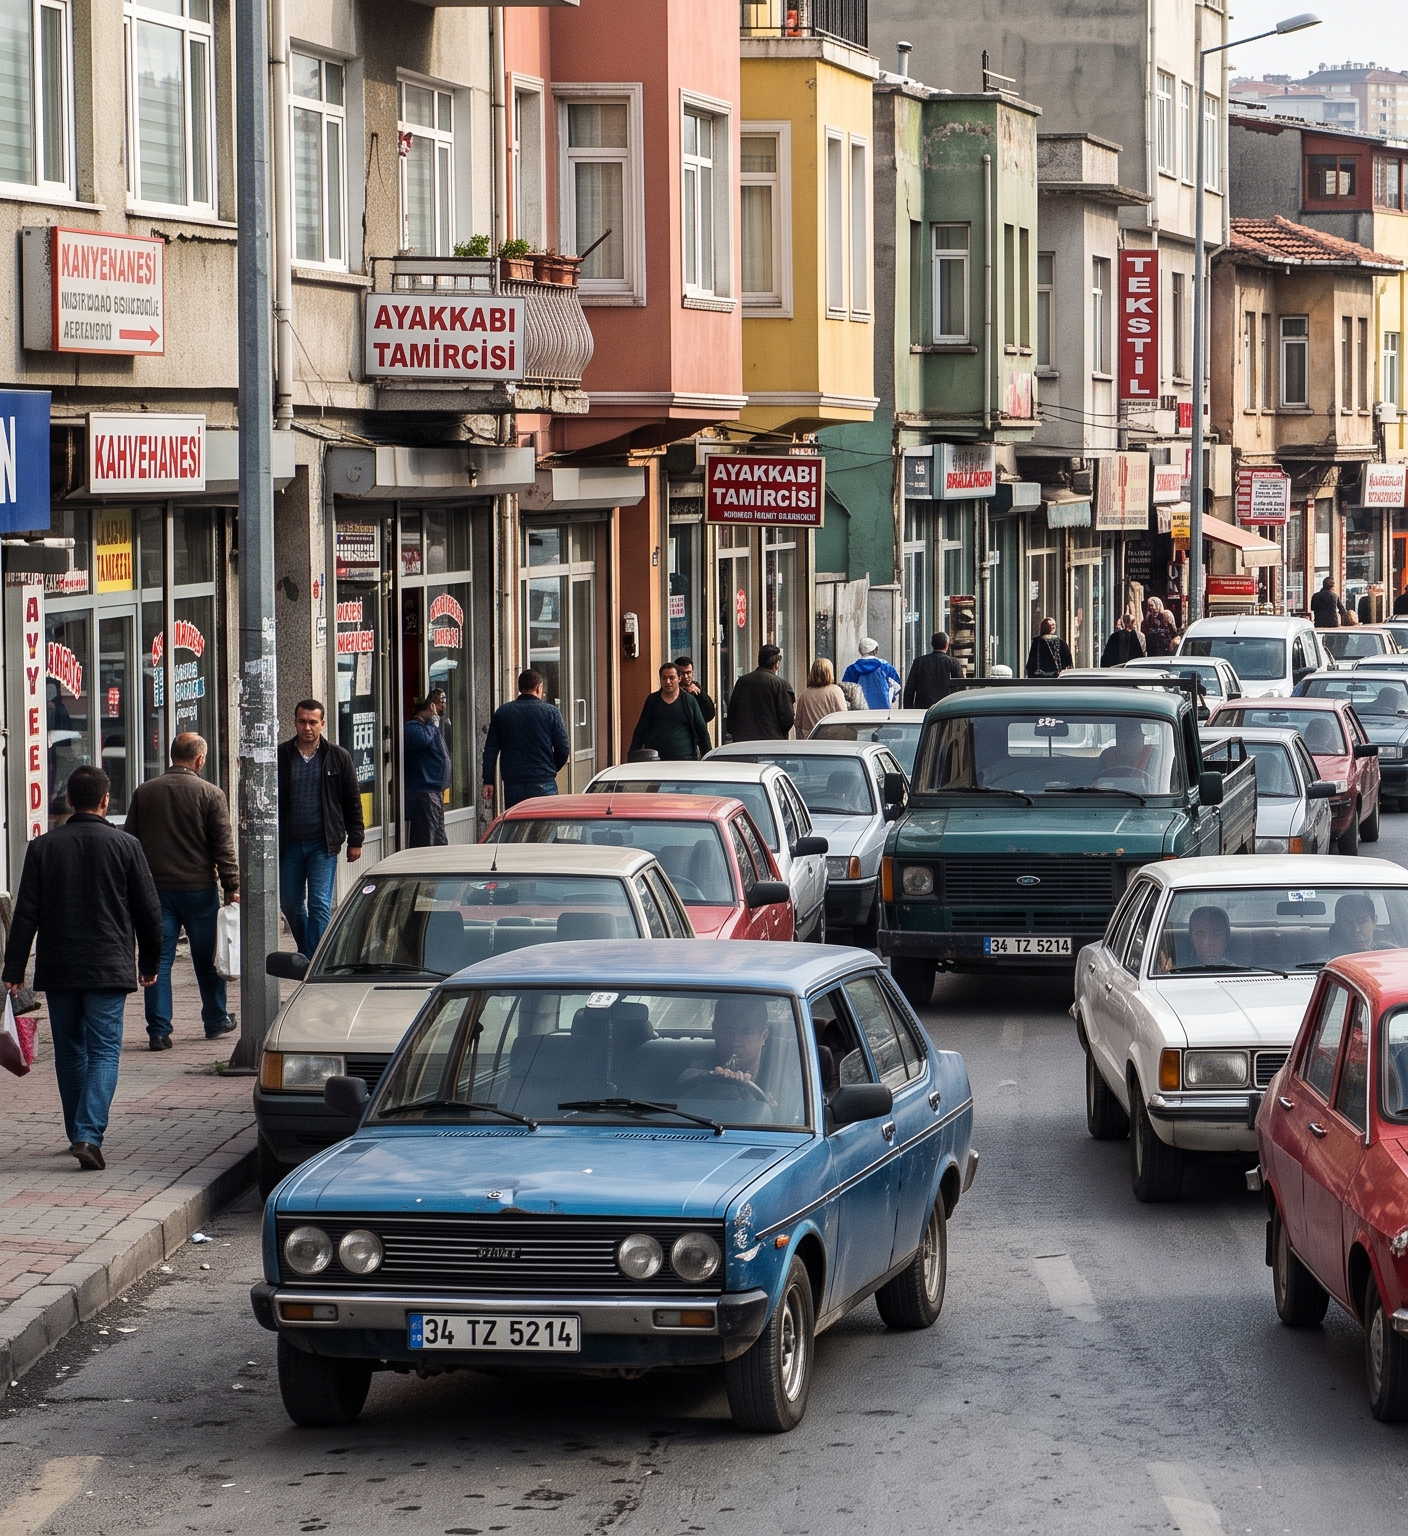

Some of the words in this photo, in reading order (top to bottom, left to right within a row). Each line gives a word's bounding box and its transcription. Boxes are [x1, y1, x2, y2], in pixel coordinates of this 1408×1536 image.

[374, 305, 515, 332] AYAKKABI
[1126, 257, 1153, 394] TEKSTİL
[373, 338, 515, 370] TAMİRCİSİ
[95, 426, 201, 479] KAHVEHANESİ
[713, 464, 817, 483] AYAKKABI
[713, 485, 817, 507] TAMİRCİSİ
[992, 939, 1008, 952] 34
[1015, 939, 1031, 952] TZ
[1037, 939, 1069, 952] 5214
[425, 1319, 454, 1344] 34
[467, 1320, 497, 1346] TZ
[510, 1320, 572, 1347] 5214
